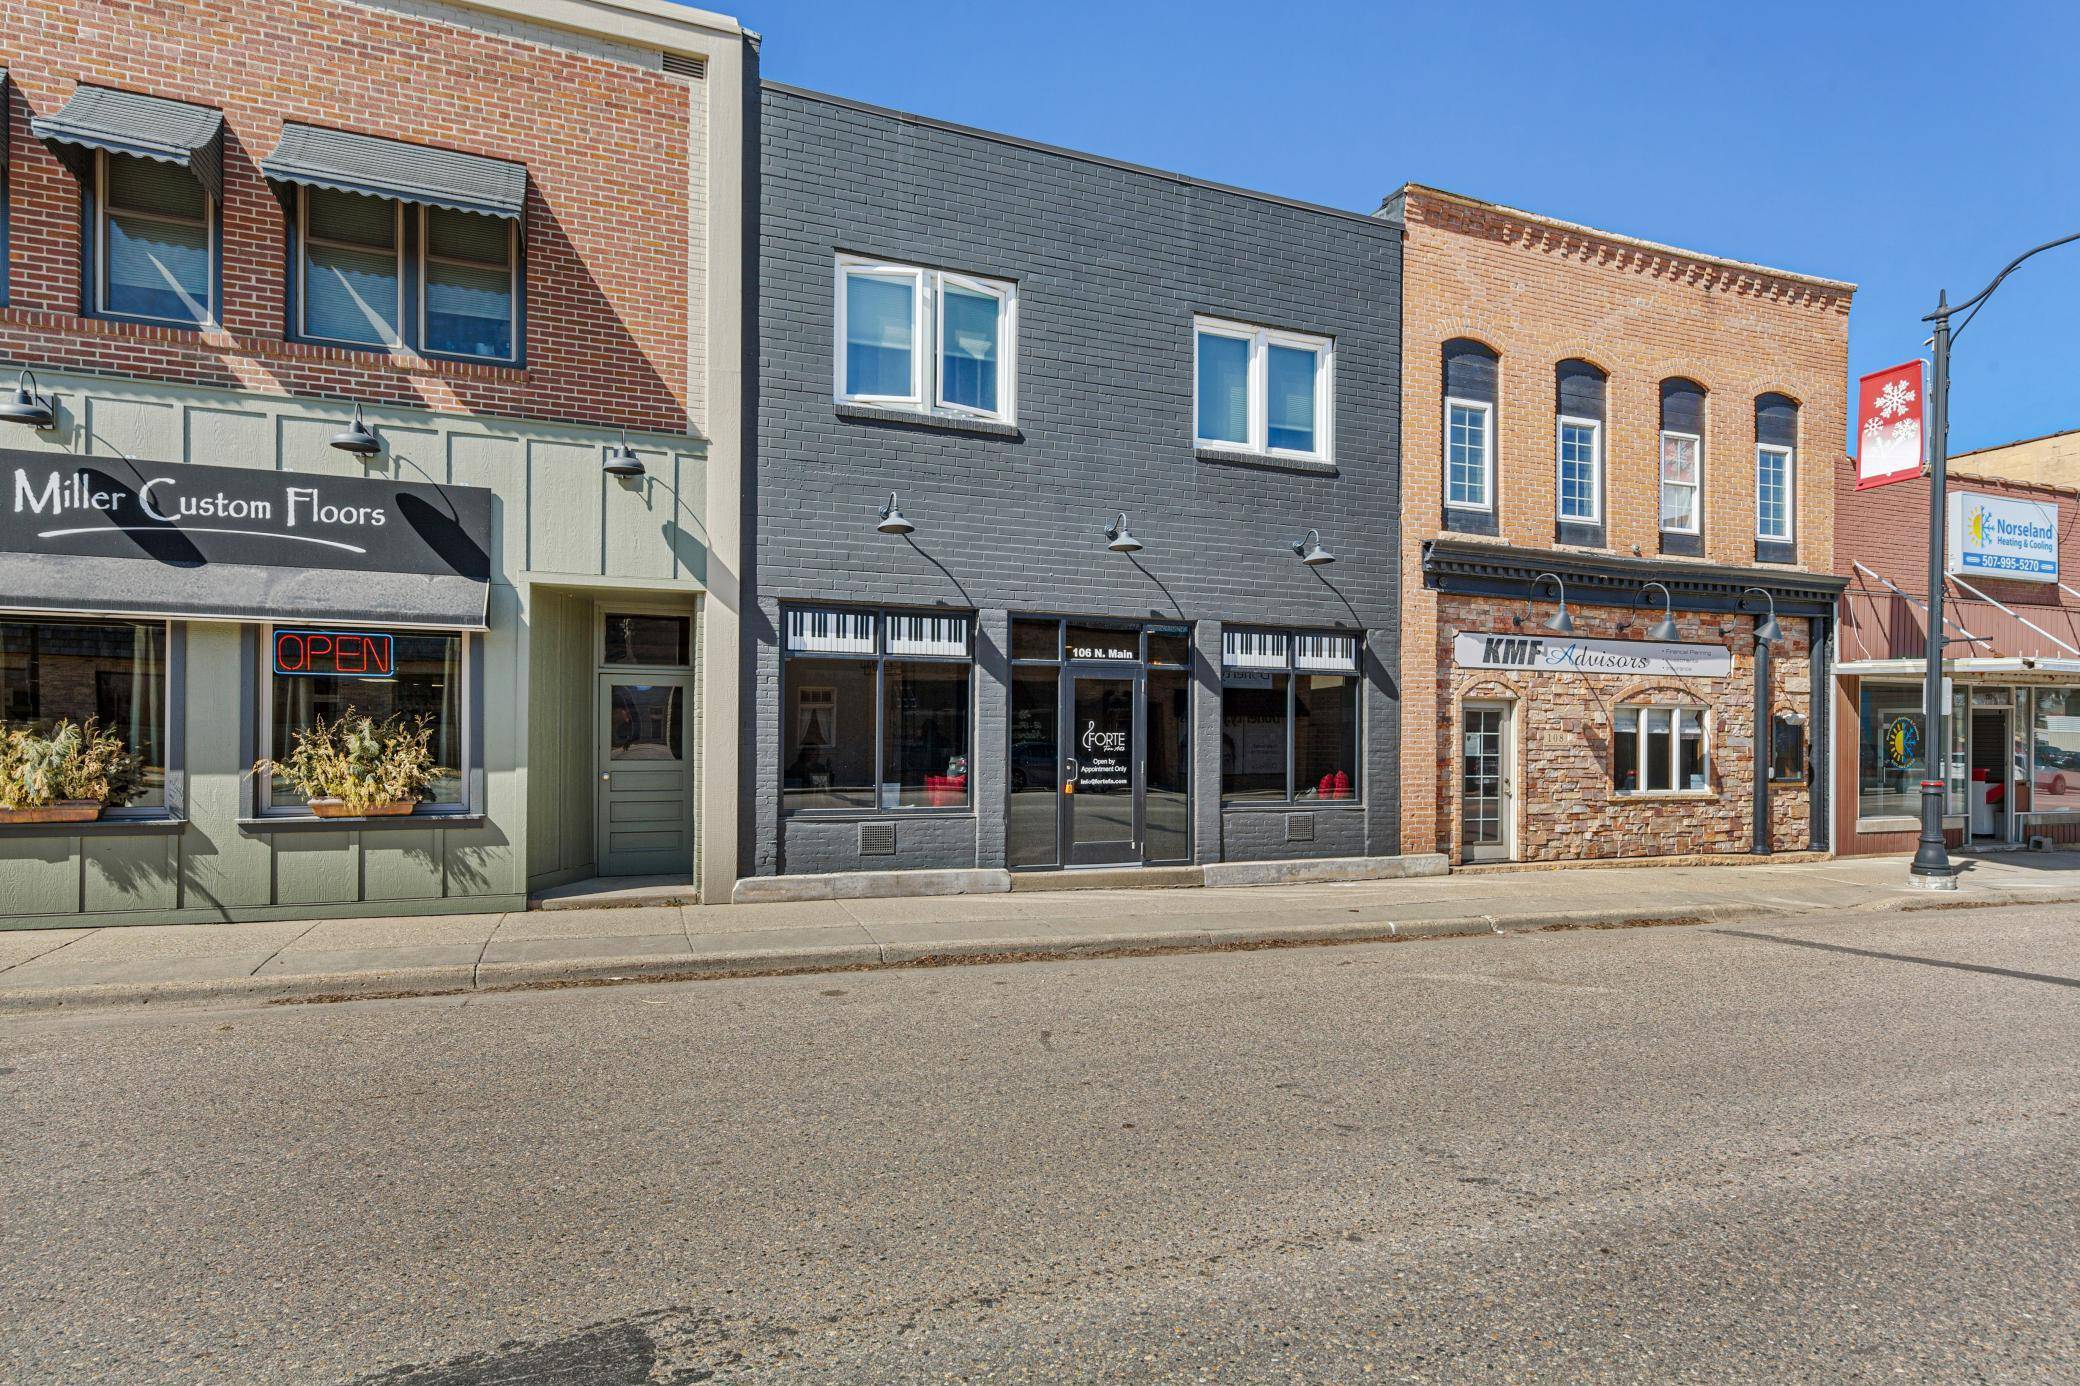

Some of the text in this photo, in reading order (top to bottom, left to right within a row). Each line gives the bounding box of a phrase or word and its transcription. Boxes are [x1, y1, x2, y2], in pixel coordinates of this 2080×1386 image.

[14, 468, 386, 527] Miller Custom Floors
[1997, 519, 2053, 539] Norseland
[1997, 536, 2022, 549] Heating
[2029, 540, 2052, 552] Cooling
[1982, 555, 2039, 571] 507-995-5270
[277, 634, 389, 673] OPEN
[1073, 648, 1133, 659] 106 N. Main
[1482, 637, 1650, 669] KMF Advisors
[1088, 732, 1126, 746] FORTE
[1093, 758, 1115, 766] Open by
